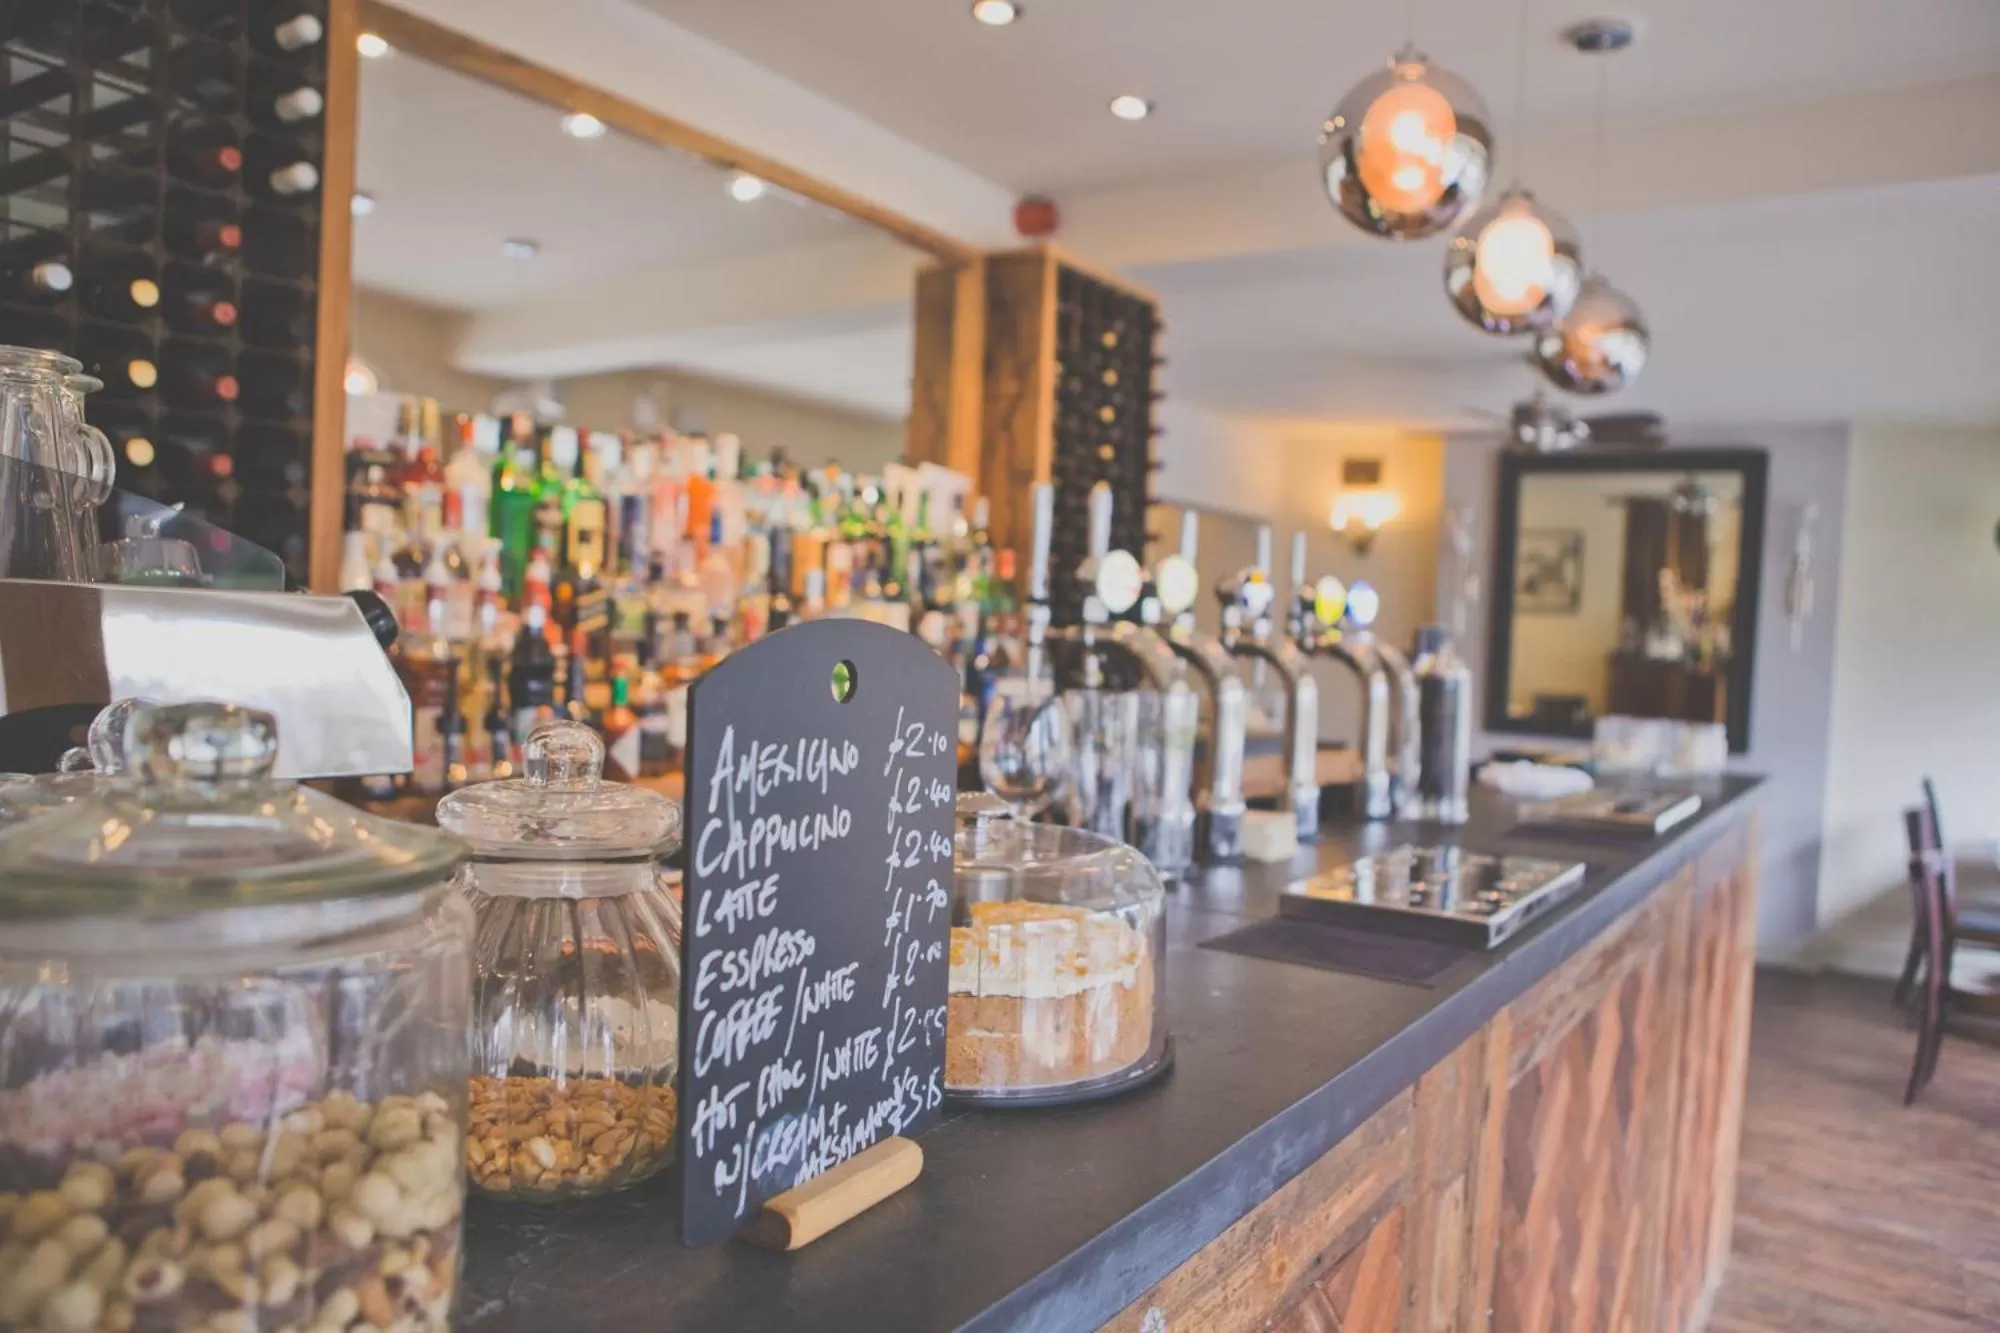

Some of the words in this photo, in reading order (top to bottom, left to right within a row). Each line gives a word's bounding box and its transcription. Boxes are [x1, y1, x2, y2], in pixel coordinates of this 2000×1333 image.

[708, 725, 859, 816] AMERICANO
[884, 706, 948, 776] £2.10
[695, 804, 851, 879] CAPPUCINO
[887, 768, 952, 834] £2.40
[695, 874, 780, 937] LATTE
[885, 825, 952, 891] £2.40
[691, 1082, 751, 1158] HOT
